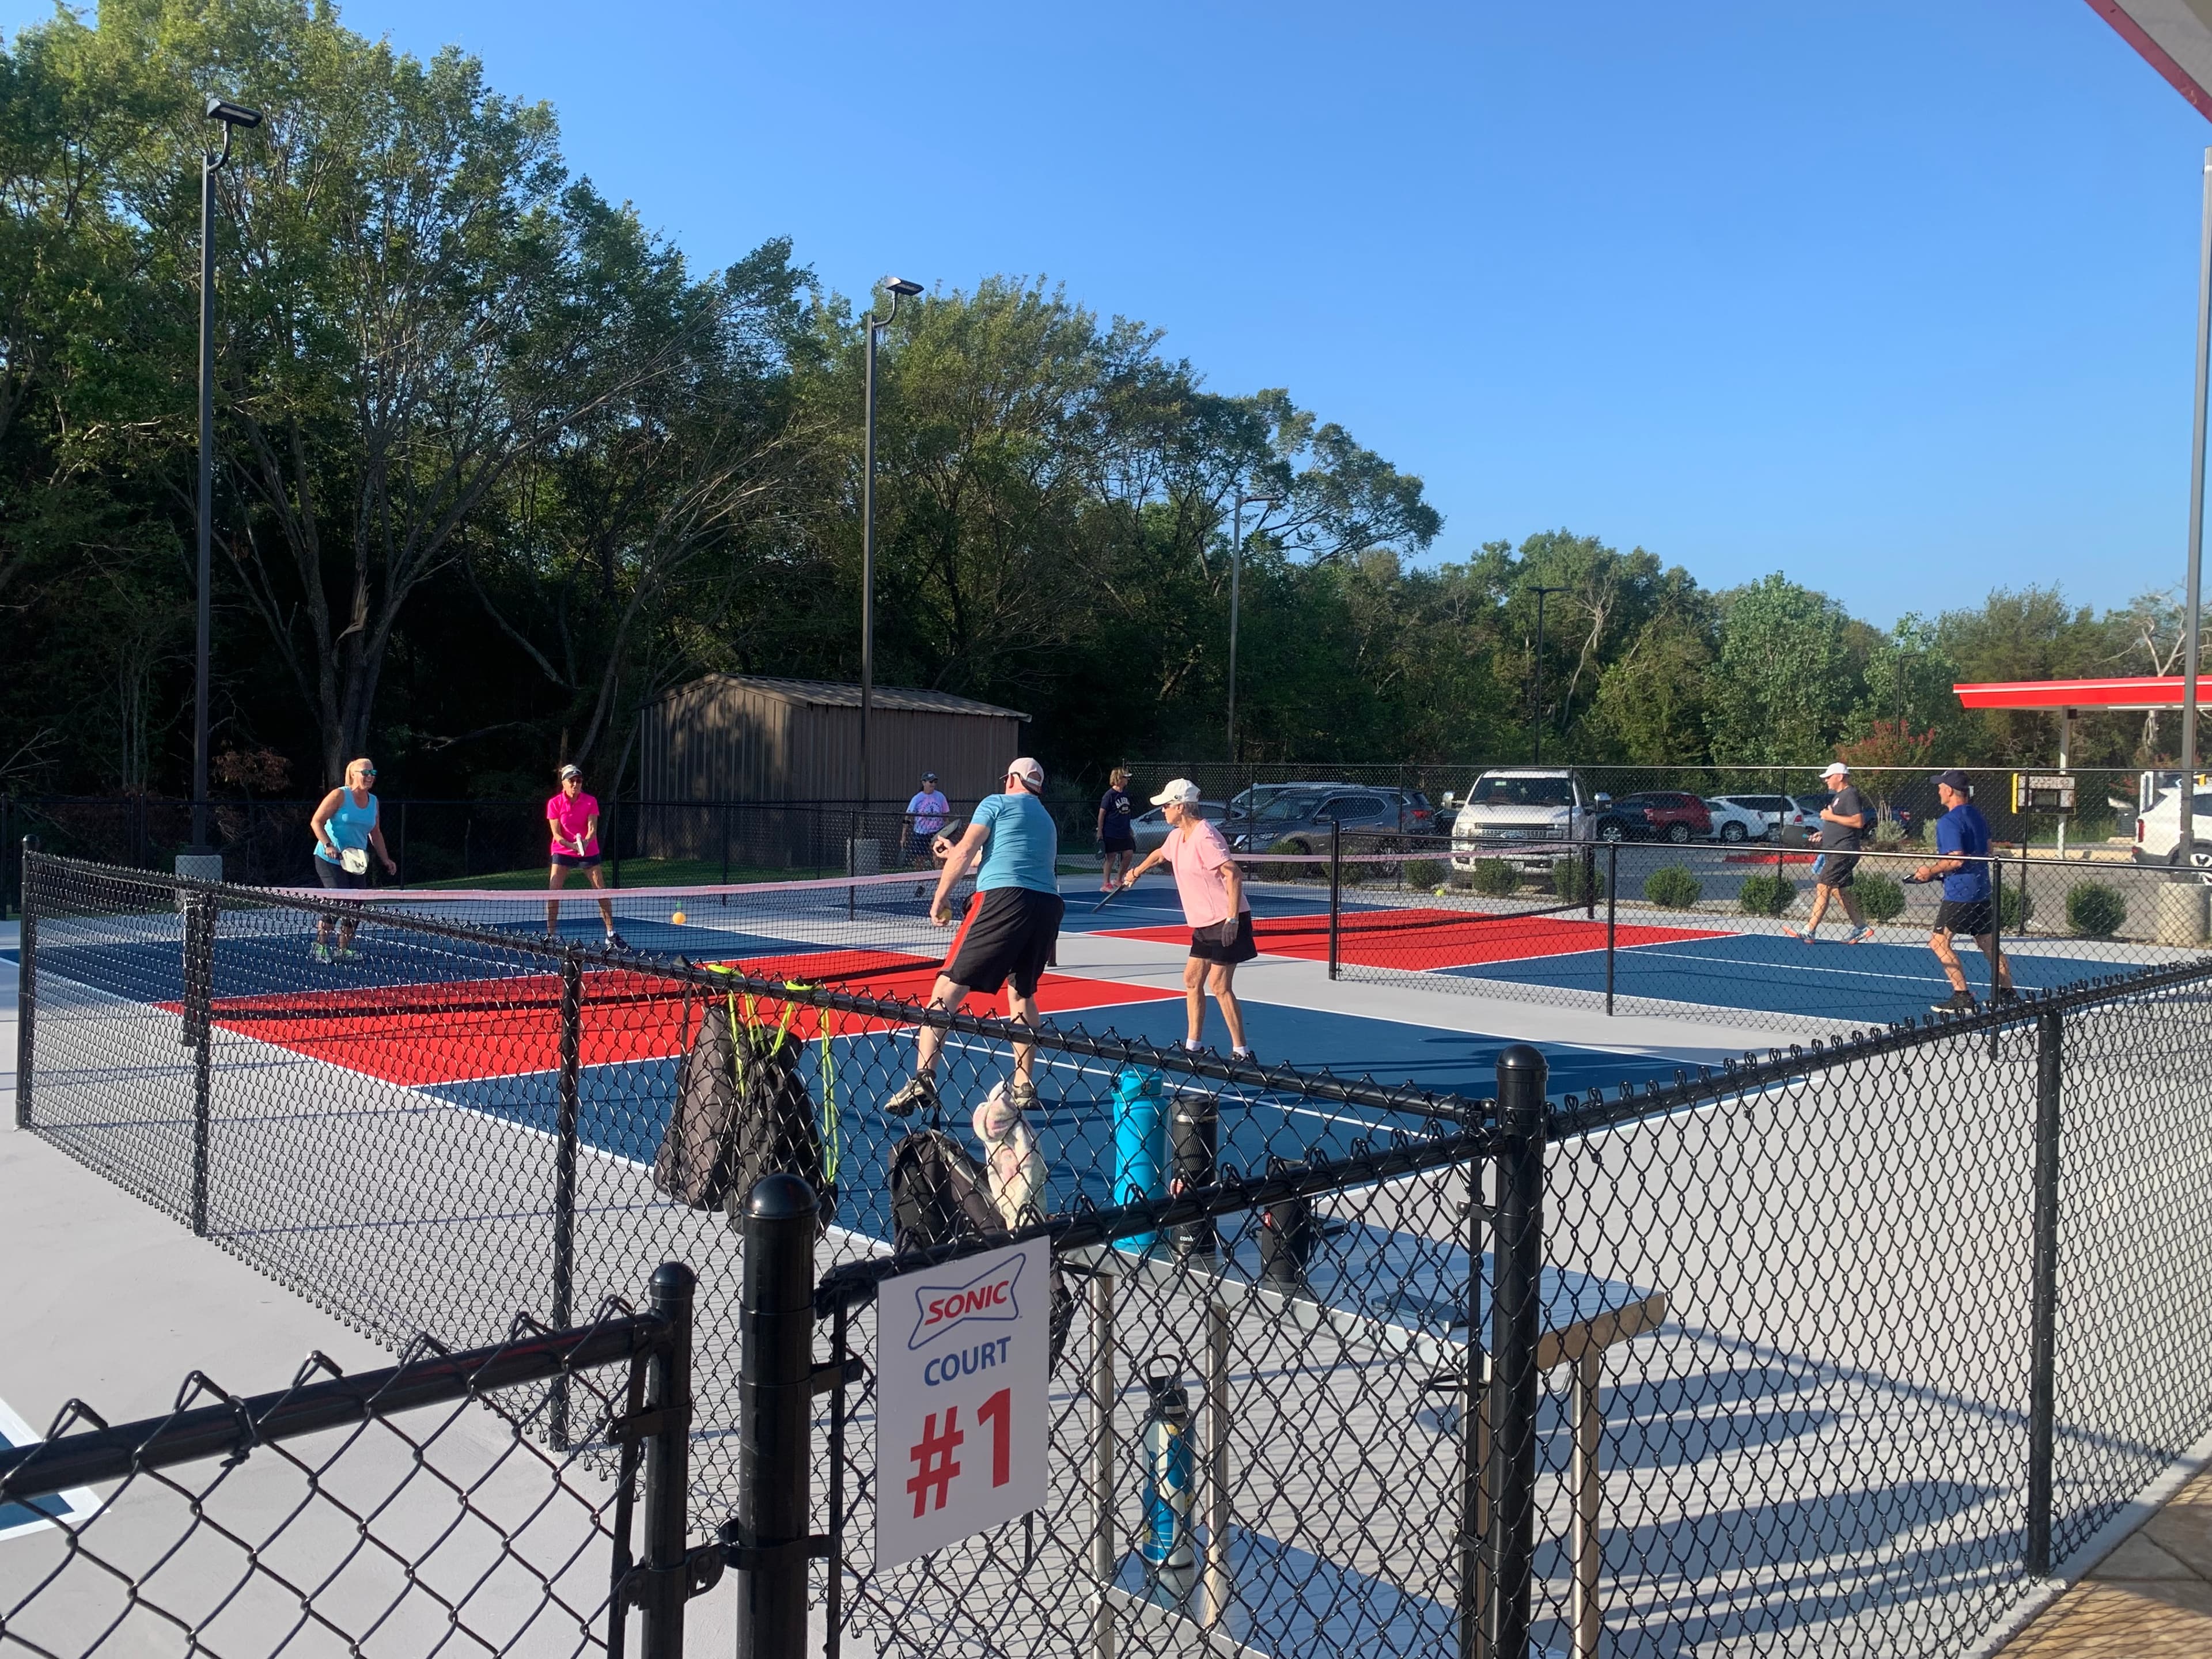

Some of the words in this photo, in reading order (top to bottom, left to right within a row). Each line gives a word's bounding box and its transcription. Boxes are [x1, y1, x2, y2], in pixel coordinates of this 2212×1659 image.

[924, 1280, 1009, 1325] SONIC
[923, 1336, 1012, 1387] COURT
[906, 1387, 1011, 1519] #1
